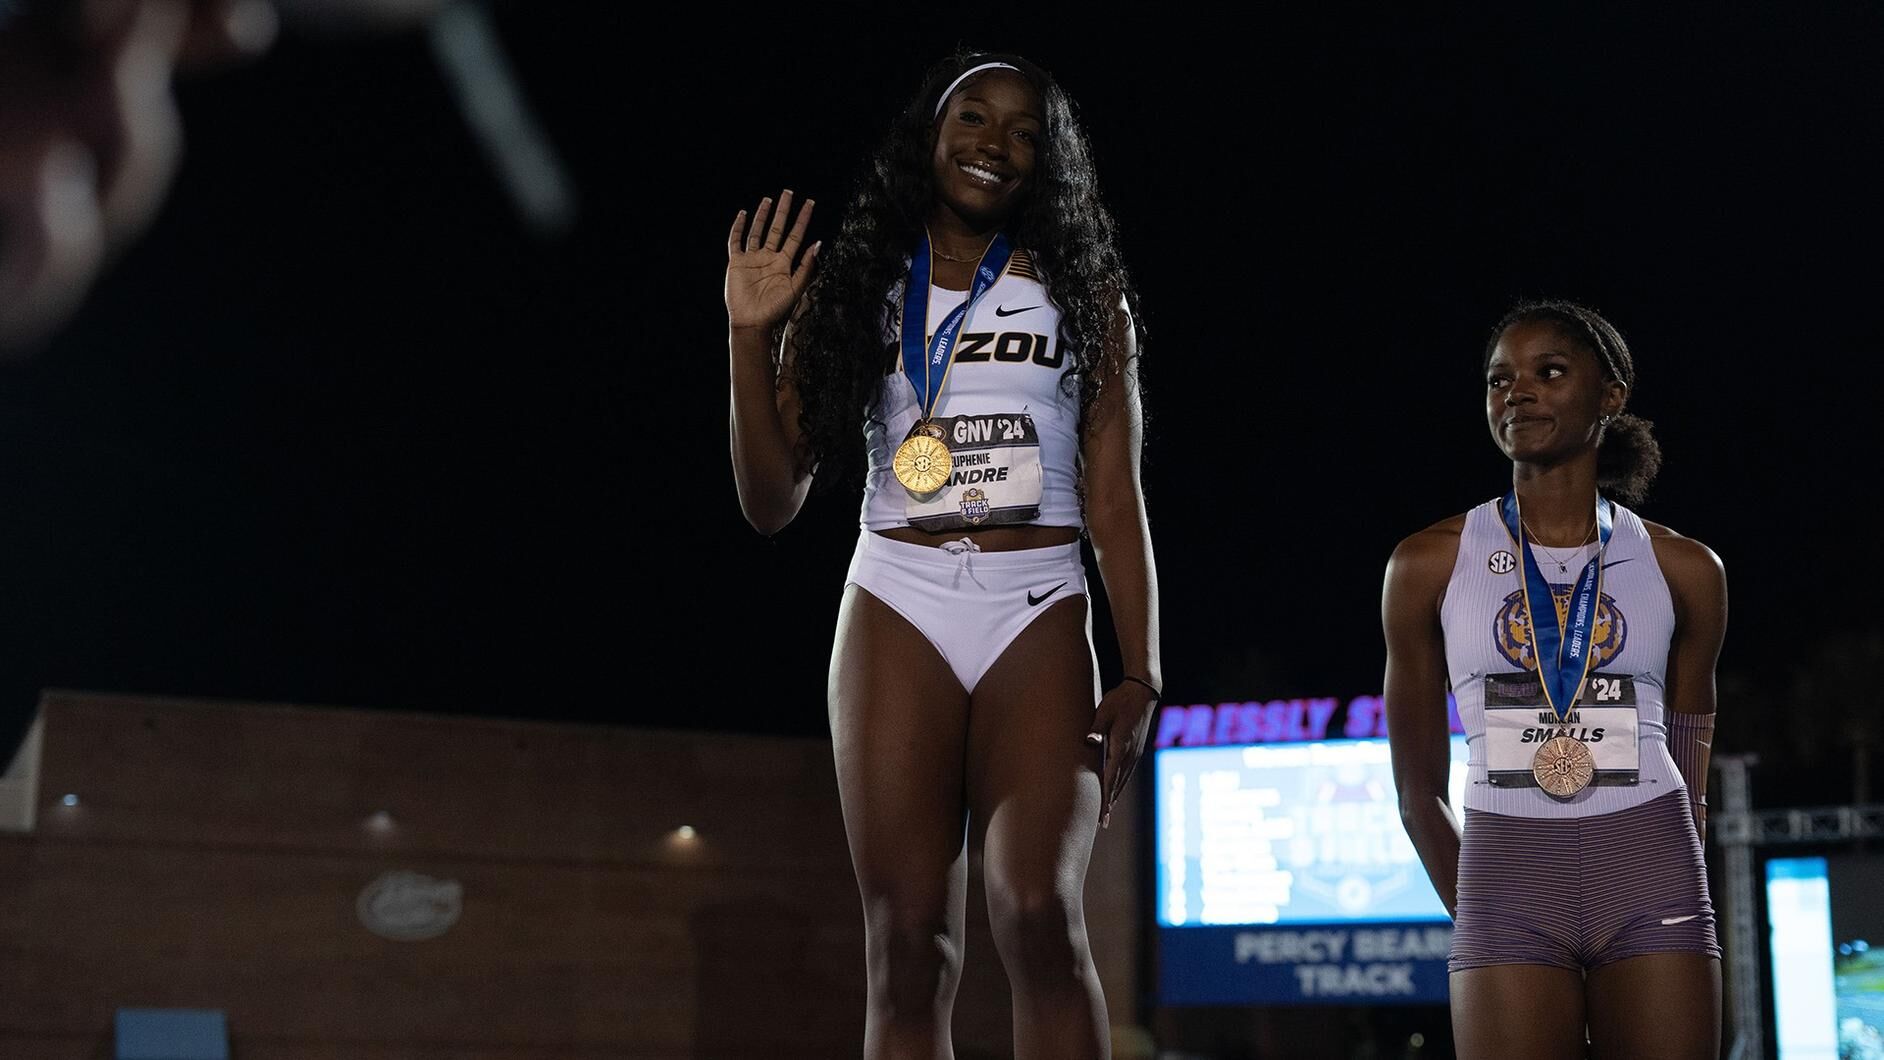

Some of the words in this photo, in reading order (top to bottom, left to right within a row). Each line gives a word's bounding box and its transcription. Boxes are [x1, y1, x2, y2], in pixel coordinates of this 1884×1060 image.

[931, 337, 949, 366] LEADERS.
[953, 419, 994, 444] GNV
[952, 452, 991, 468] UPHENIE
[960, 499, 988, 509] TRACK
[1490, 552, 1516, 573] SEC
[1570, 630, 1584, 658] LEADERS.
[1154, 697, 1339, 746] PRESSLY
[1538, 711, 1580, 724] MOAN
[1234, 930, 1349, 964] PERCY
[1352, 927, 1452, 962] BEAR
[1294, 962, 1416, 997] TRACK
